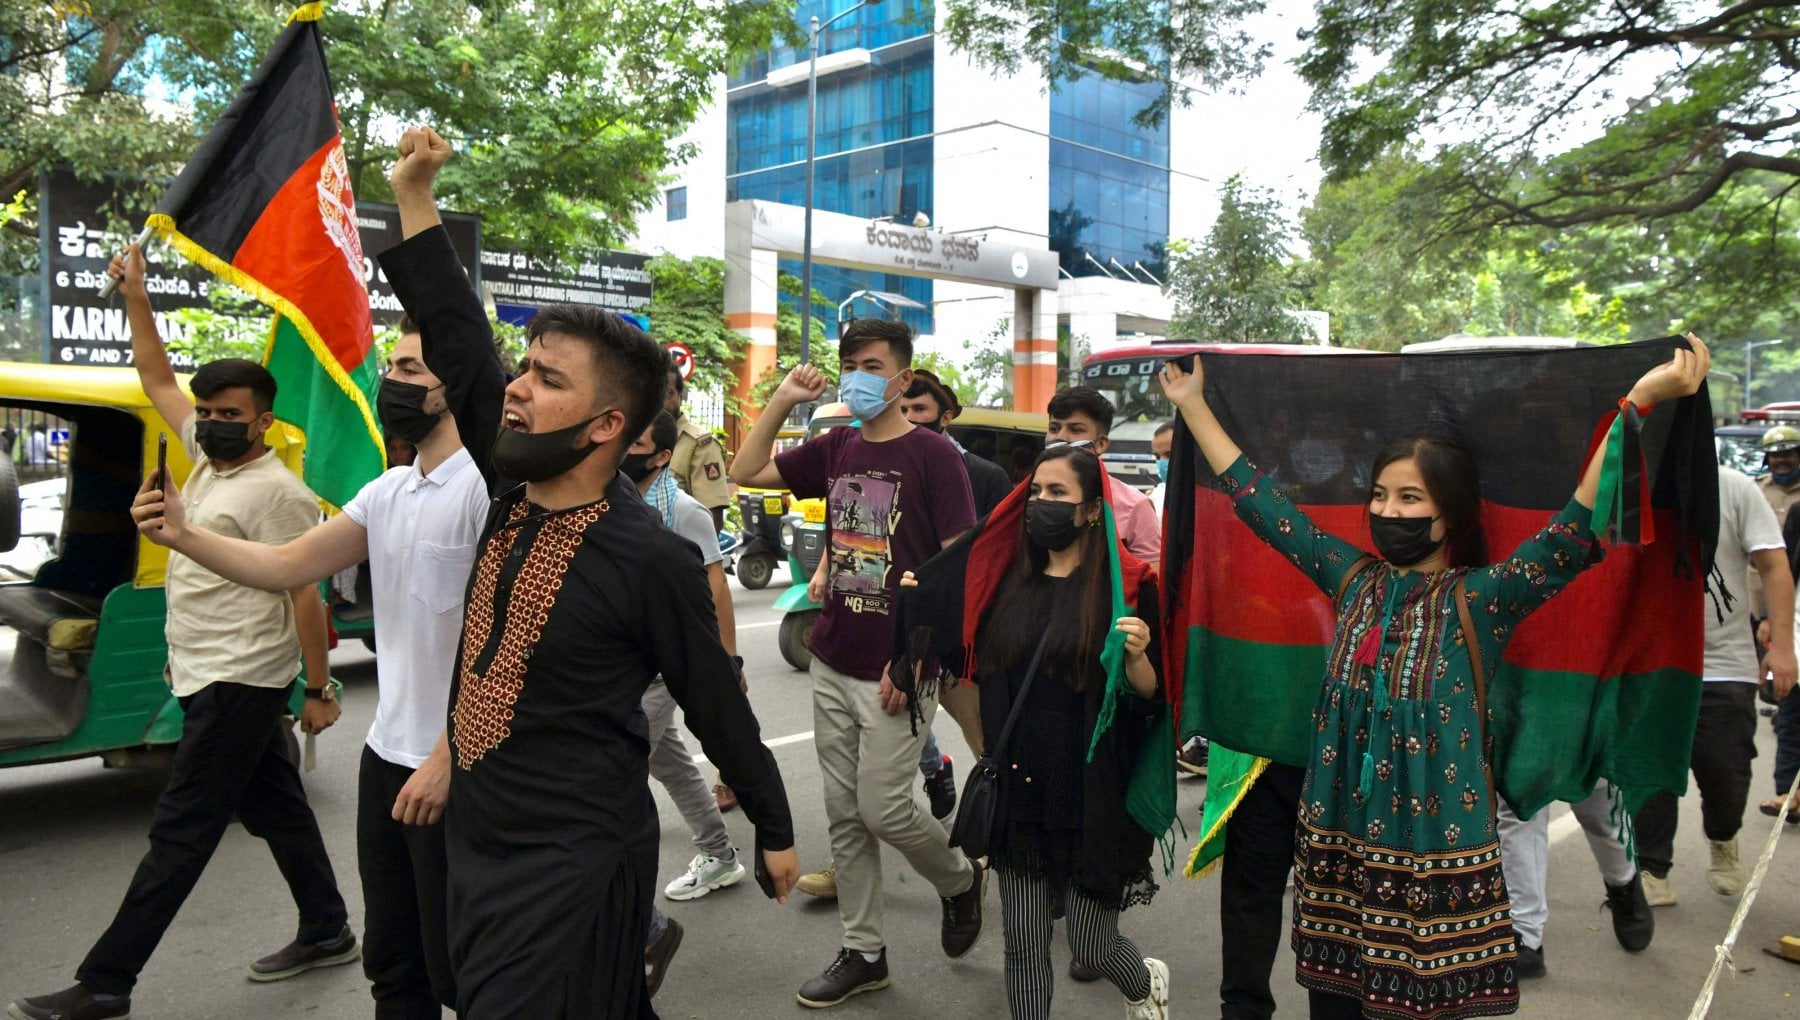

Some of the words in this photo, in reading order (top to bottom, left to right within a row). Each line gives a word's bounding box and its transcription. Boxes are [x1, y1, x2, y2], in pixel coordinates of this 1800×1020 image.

[866, 221, 933, 254] ಕಂದಾಯ
[941, 235, 979, 262] ಭವನ
[56, 271, 70, 287] 6
[515, 283, 533, 298] LAND
[534, 285, 566, 301] GRABBING
[89, 349, 121, 363] AND
